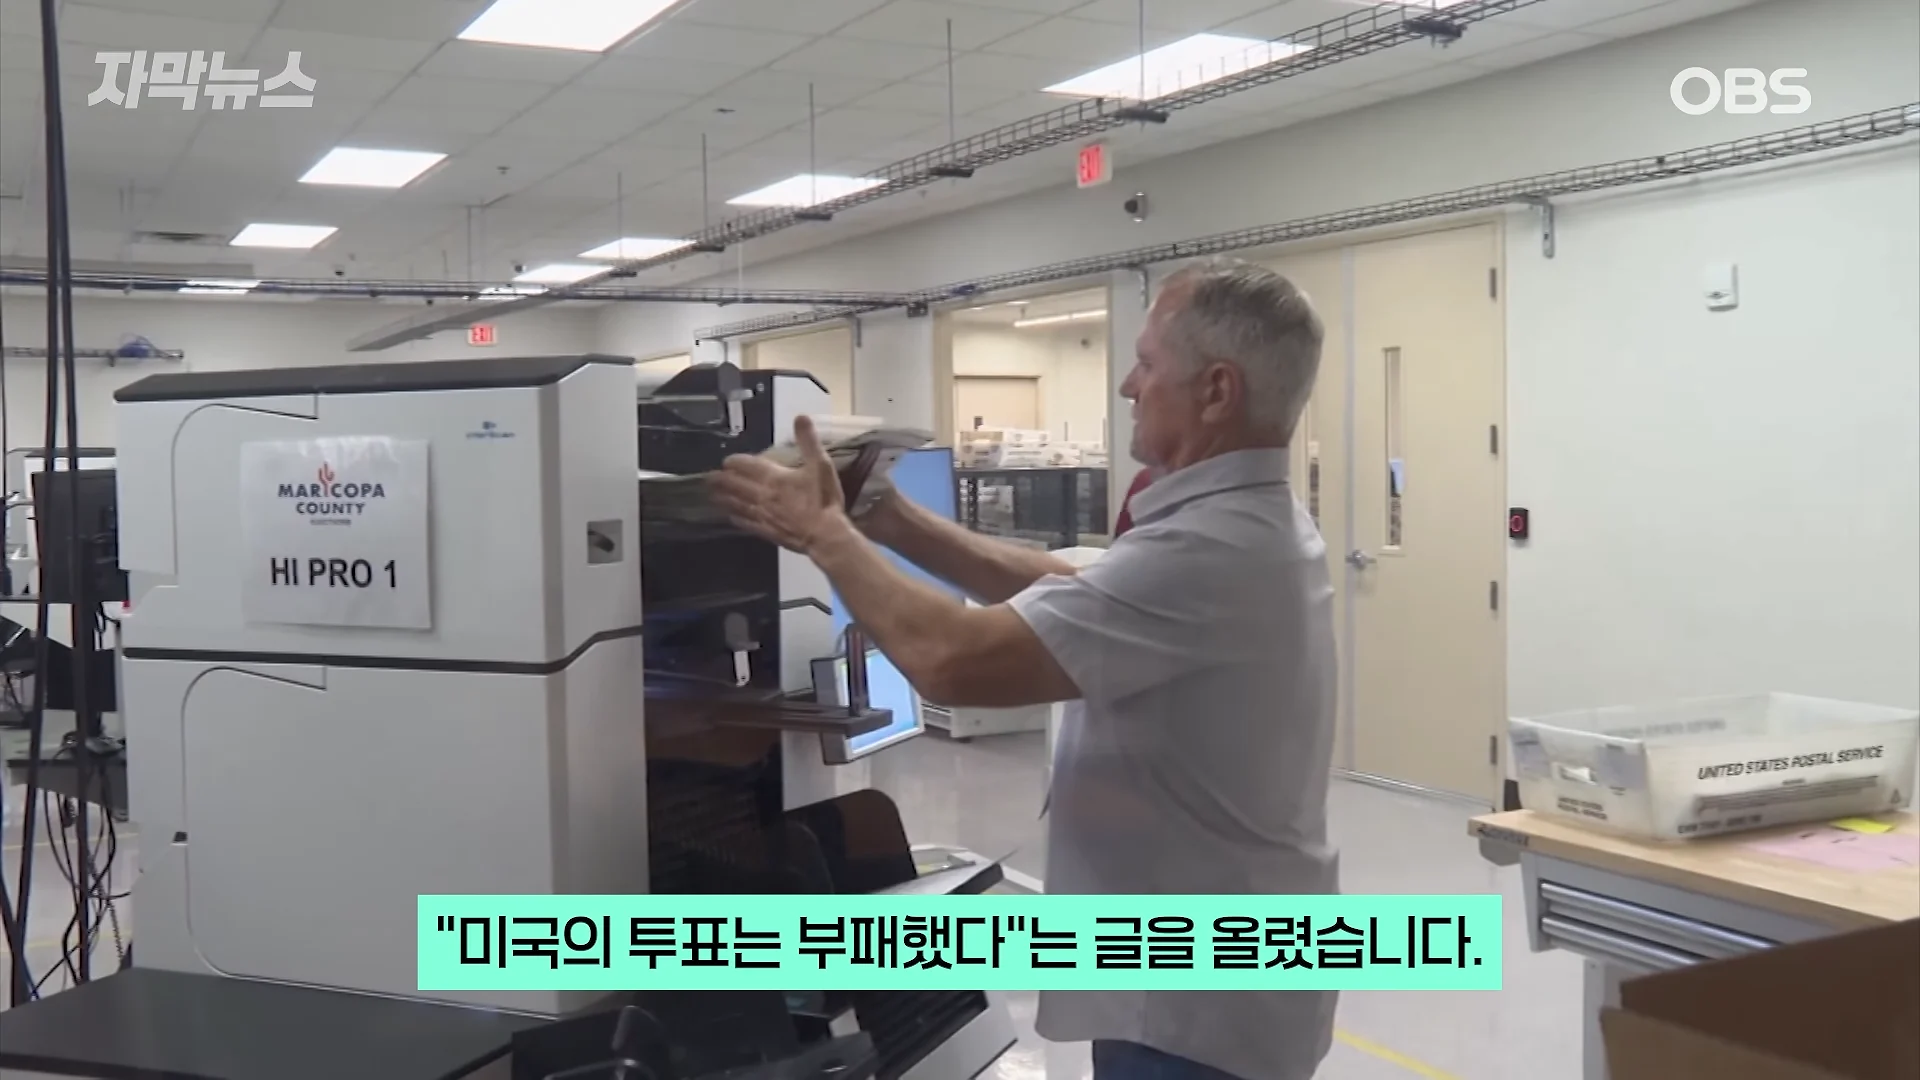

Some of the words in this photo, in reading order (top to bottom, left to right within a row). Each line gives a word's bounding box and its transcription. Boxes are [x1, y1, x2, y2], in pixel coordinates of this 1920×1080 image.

[296, 502, 365, 515] COUNTY
[270, 557, 299, 586] HI
[308, 557, 373, 588] PRO
[384, 559, 397, 588] 1
[1697, 763, 1744, 780] UNITED
[1745, 757, 1790, 775] STATES
[1791, 751, 1835, 768] POSTAL
[1836, 745, 1885, 764] SERVICE
